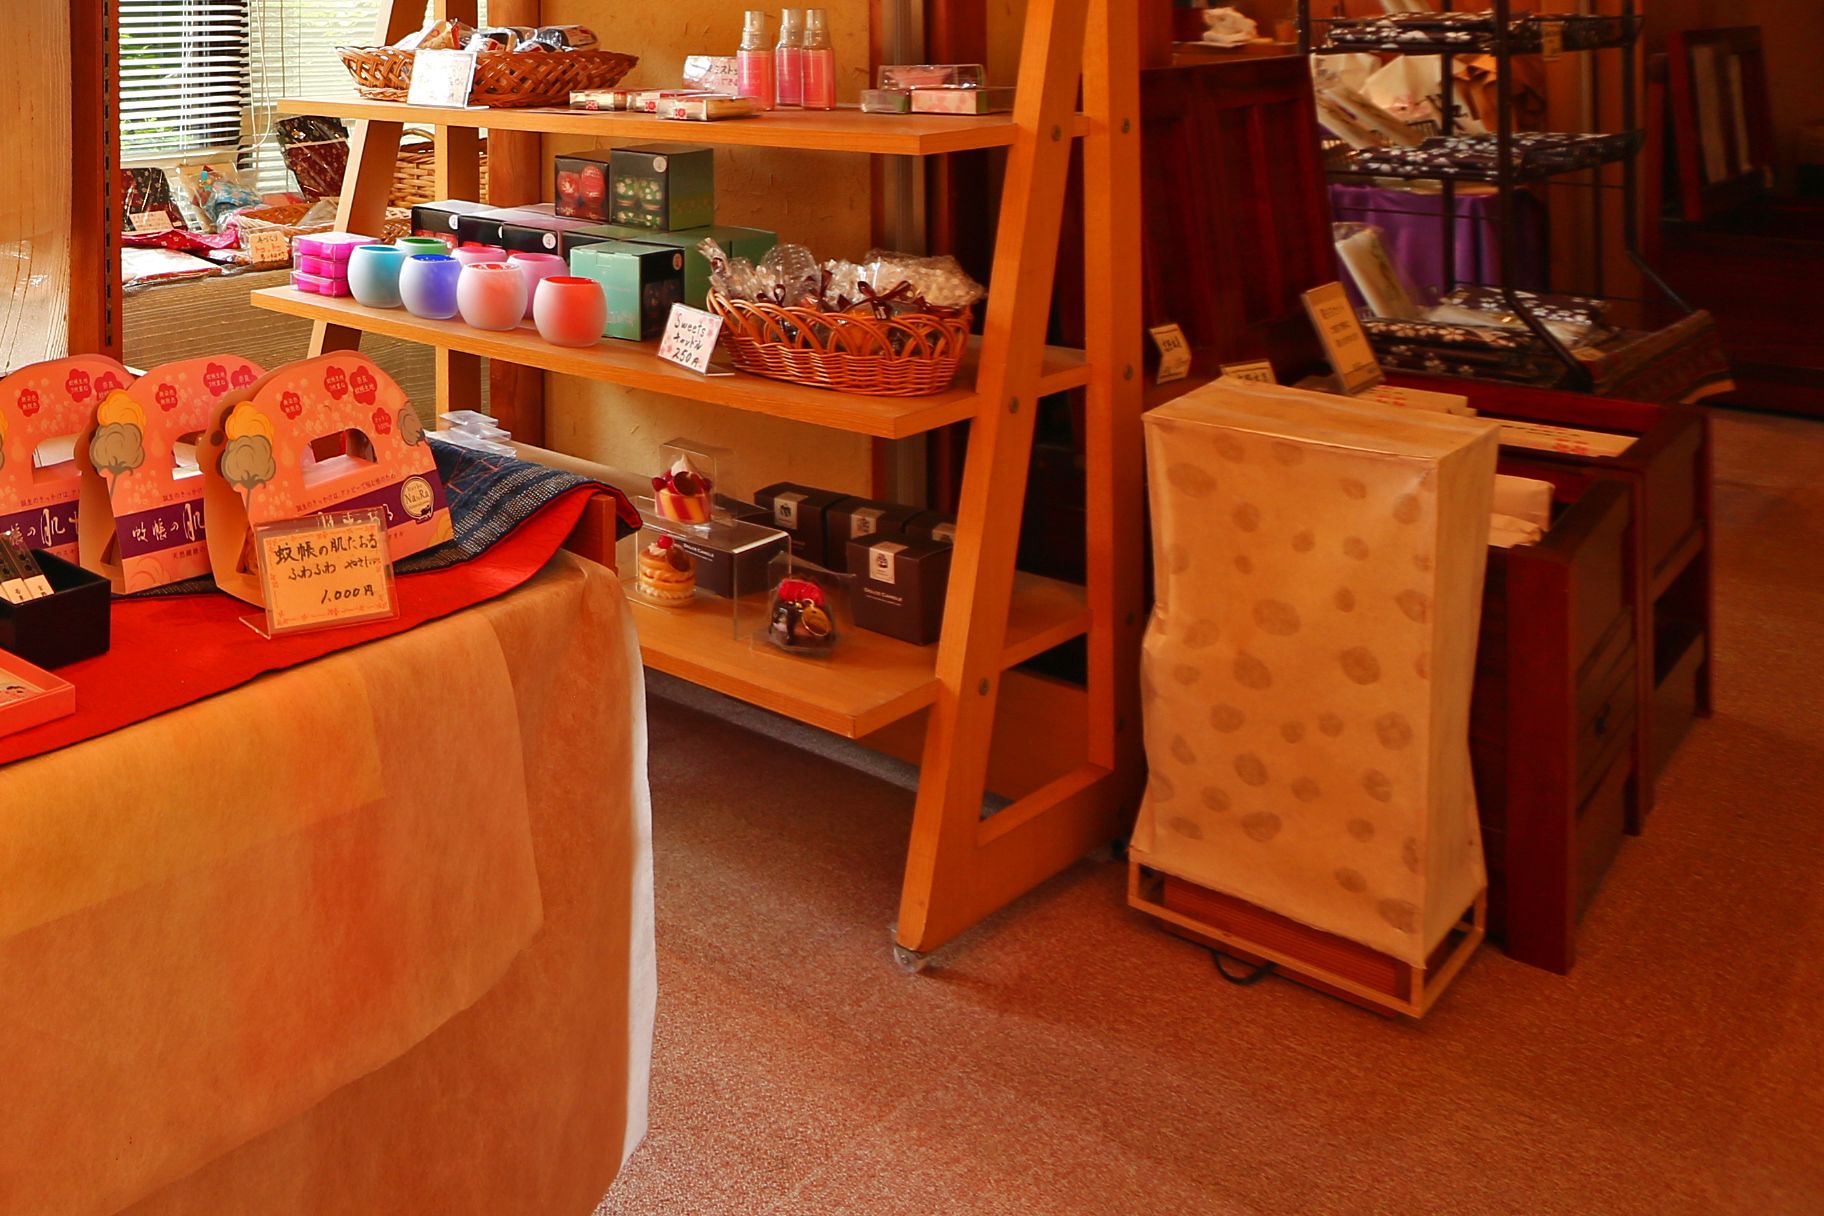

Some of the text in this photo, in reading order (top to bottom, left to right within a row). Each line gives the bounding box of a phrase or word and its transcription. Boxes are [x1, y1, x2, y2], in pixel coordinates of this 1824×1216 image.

[674, 313, 707, 337] Sweets
[275, 534, 378, 565] 蚊帳の肌たおる
[288, 563, 336, 580] ふわふわ
